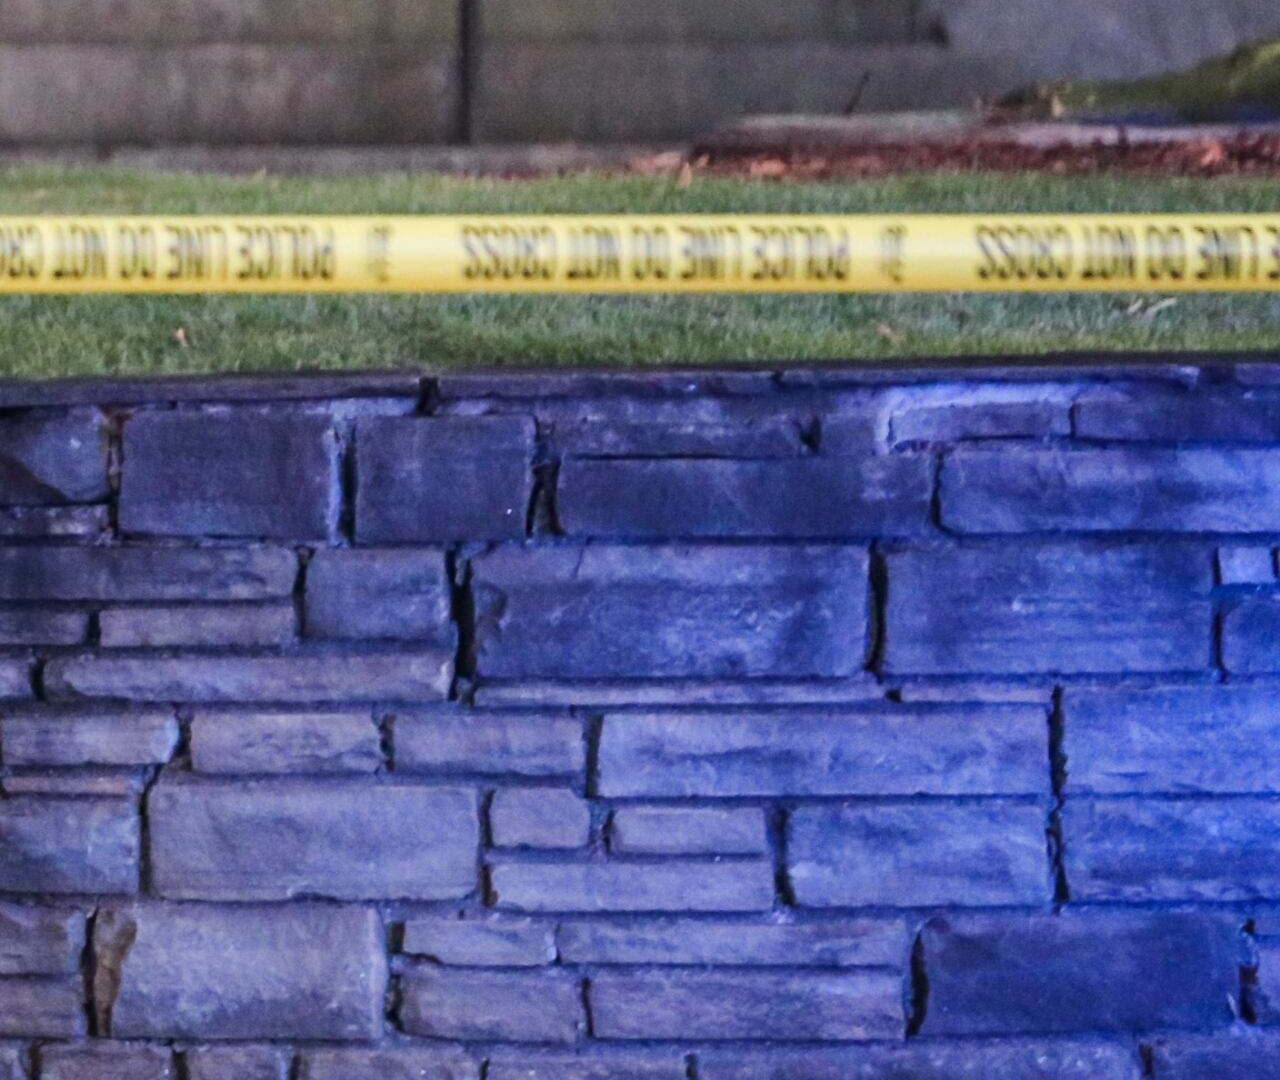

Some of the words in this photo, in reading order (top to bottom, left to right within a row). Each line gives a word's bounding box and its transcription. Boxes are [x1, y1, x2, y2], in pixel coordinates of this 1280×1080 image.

[52, 224, 108, 280] NOT
[119, 224, 157, 280] DO
[166, 224, 228, 280] LINE
[236, 224, 334, 280] POLICE
[462, 224, 557, 280] CROSS
[567, 224, 620, 280] NOT
[631, 224, 670, 280] DO
[679, 224, 741, 280] LINE
[750, 224, 849, 280] POLICE
[976, 225, 1073, 280] CROSS
[1081, 225, 1137, 280] NOT
[1145, 225, 1185, 280] DO
[1192, 225, 1258, 280] LINE
